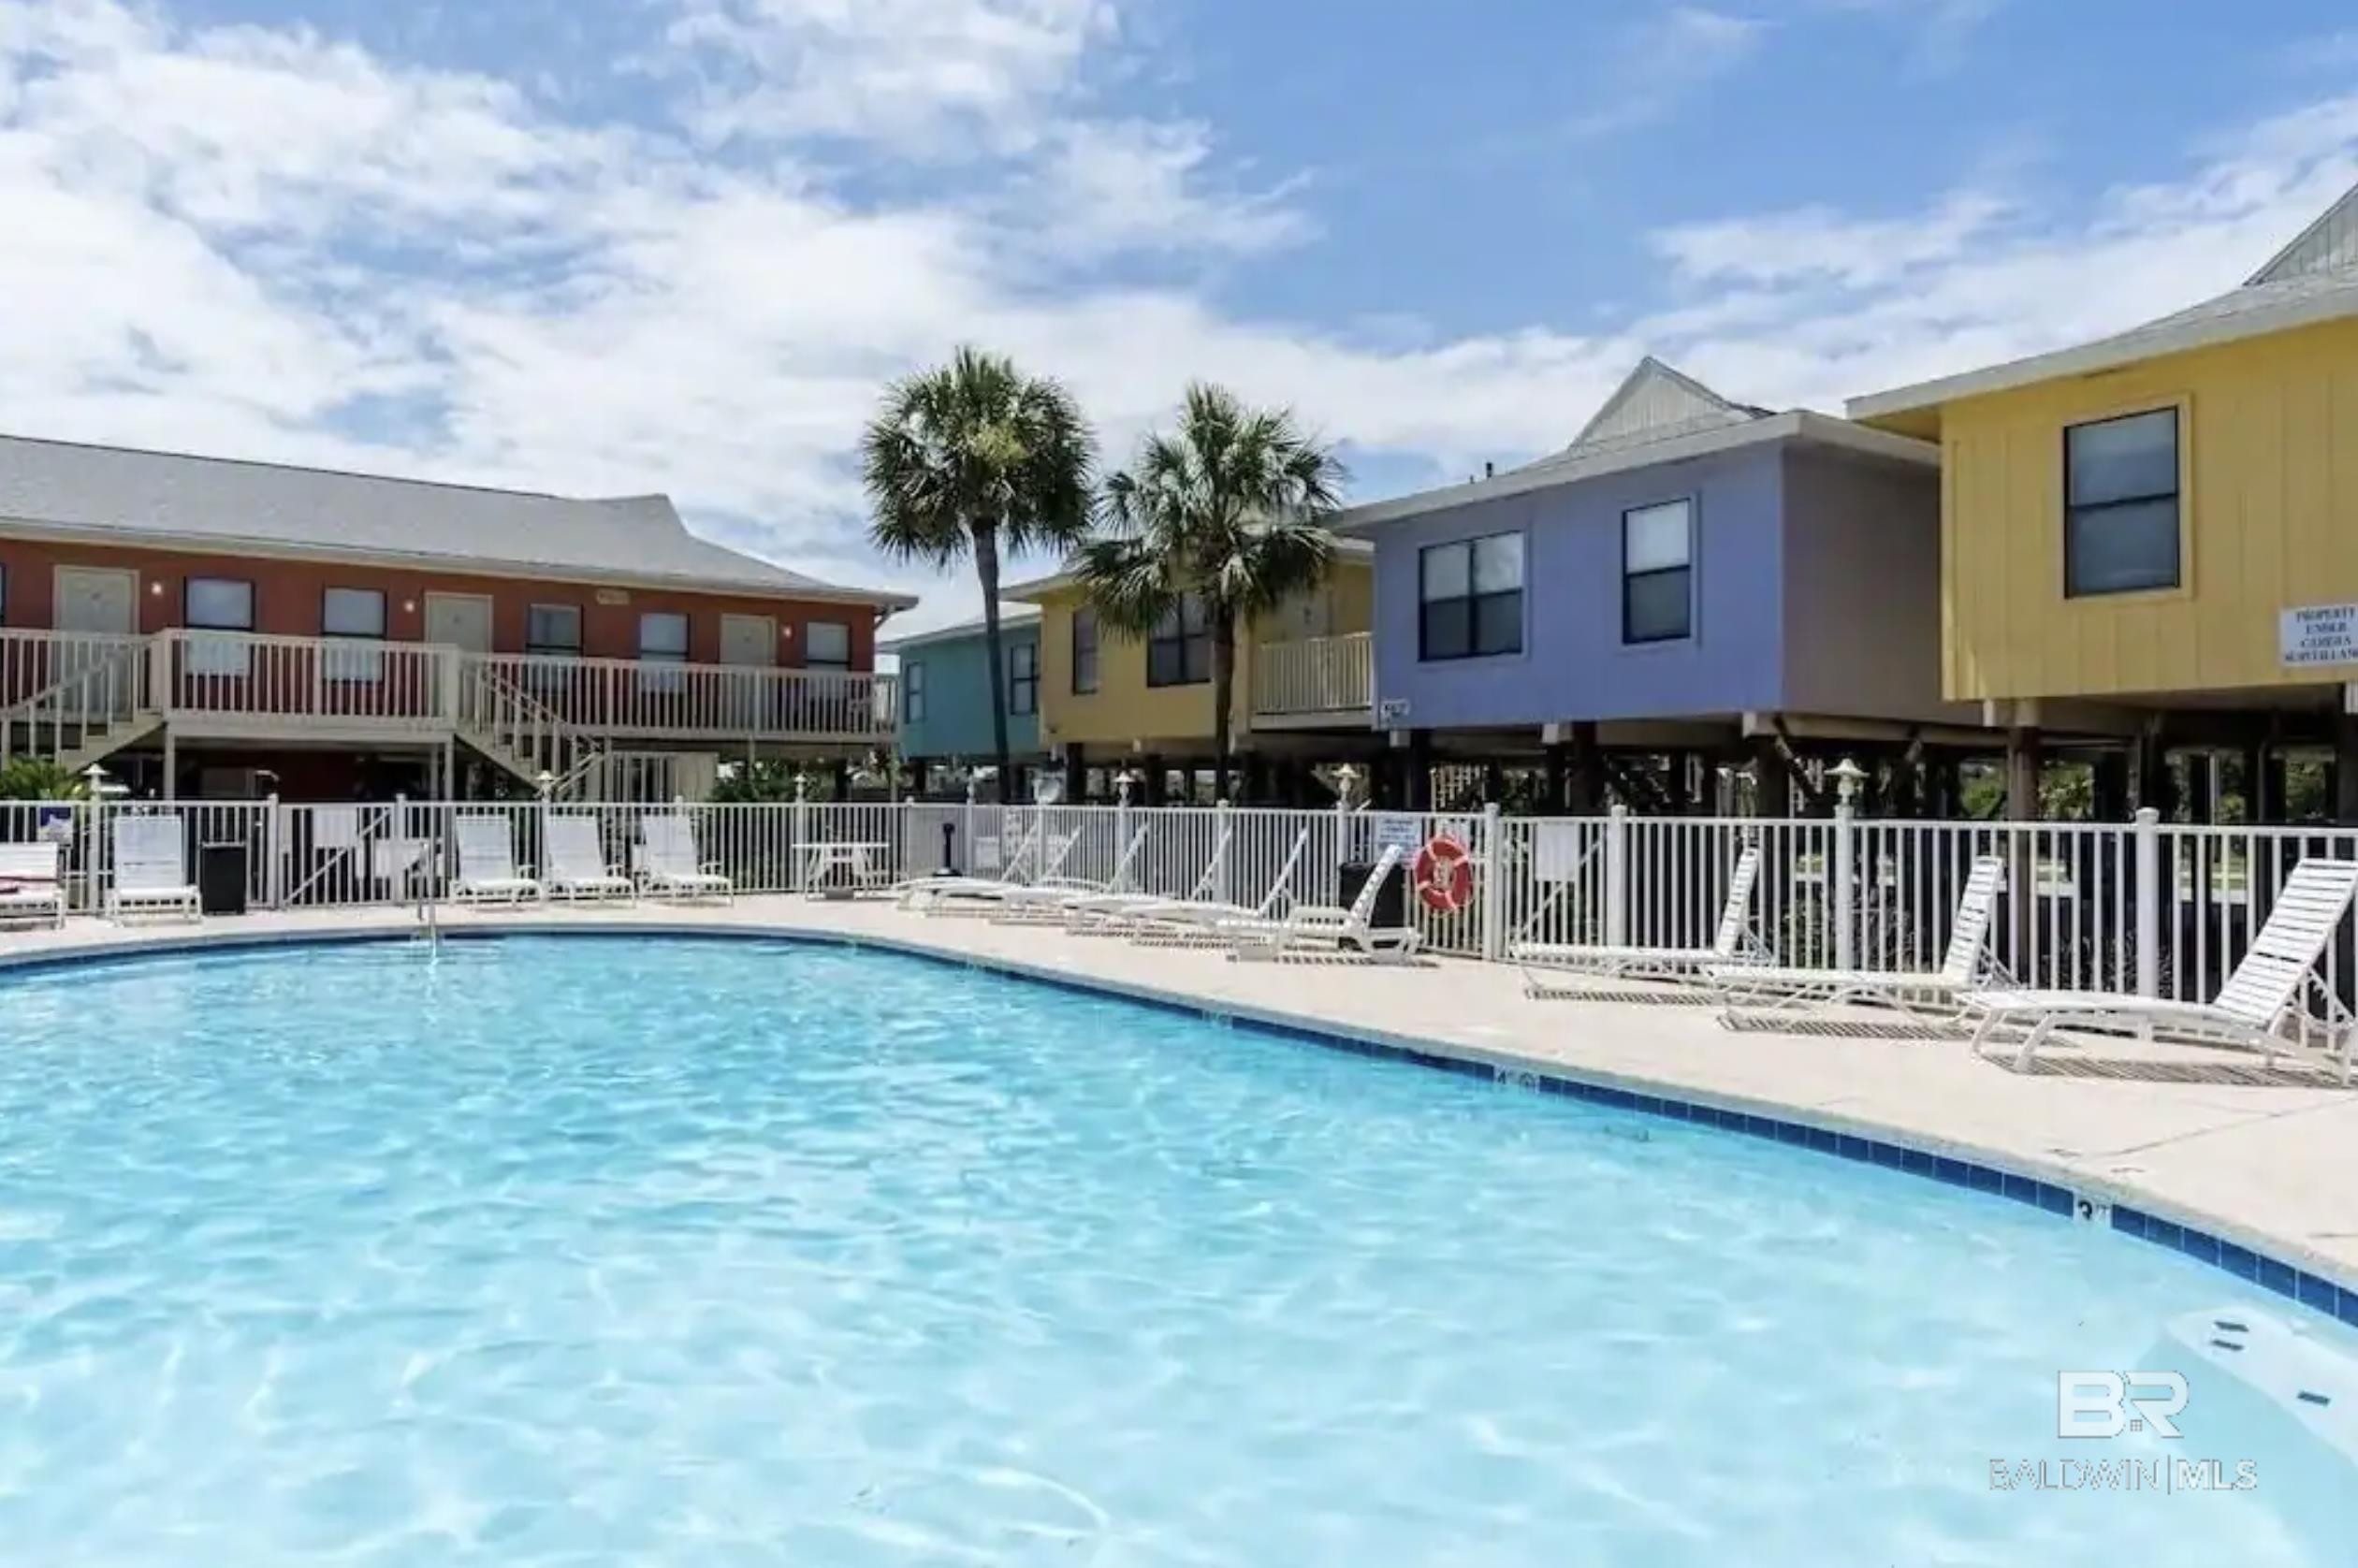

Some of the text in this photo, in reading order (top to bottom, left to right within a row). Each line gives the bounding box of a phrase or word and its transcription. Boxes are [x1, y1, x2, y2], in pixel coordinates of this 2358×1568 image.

[2295, 606, 2355, 623] PROPERTY
[2305, 621, 2348, 635] UNDER
[2299, 635, 2351, 648] CAMERA
